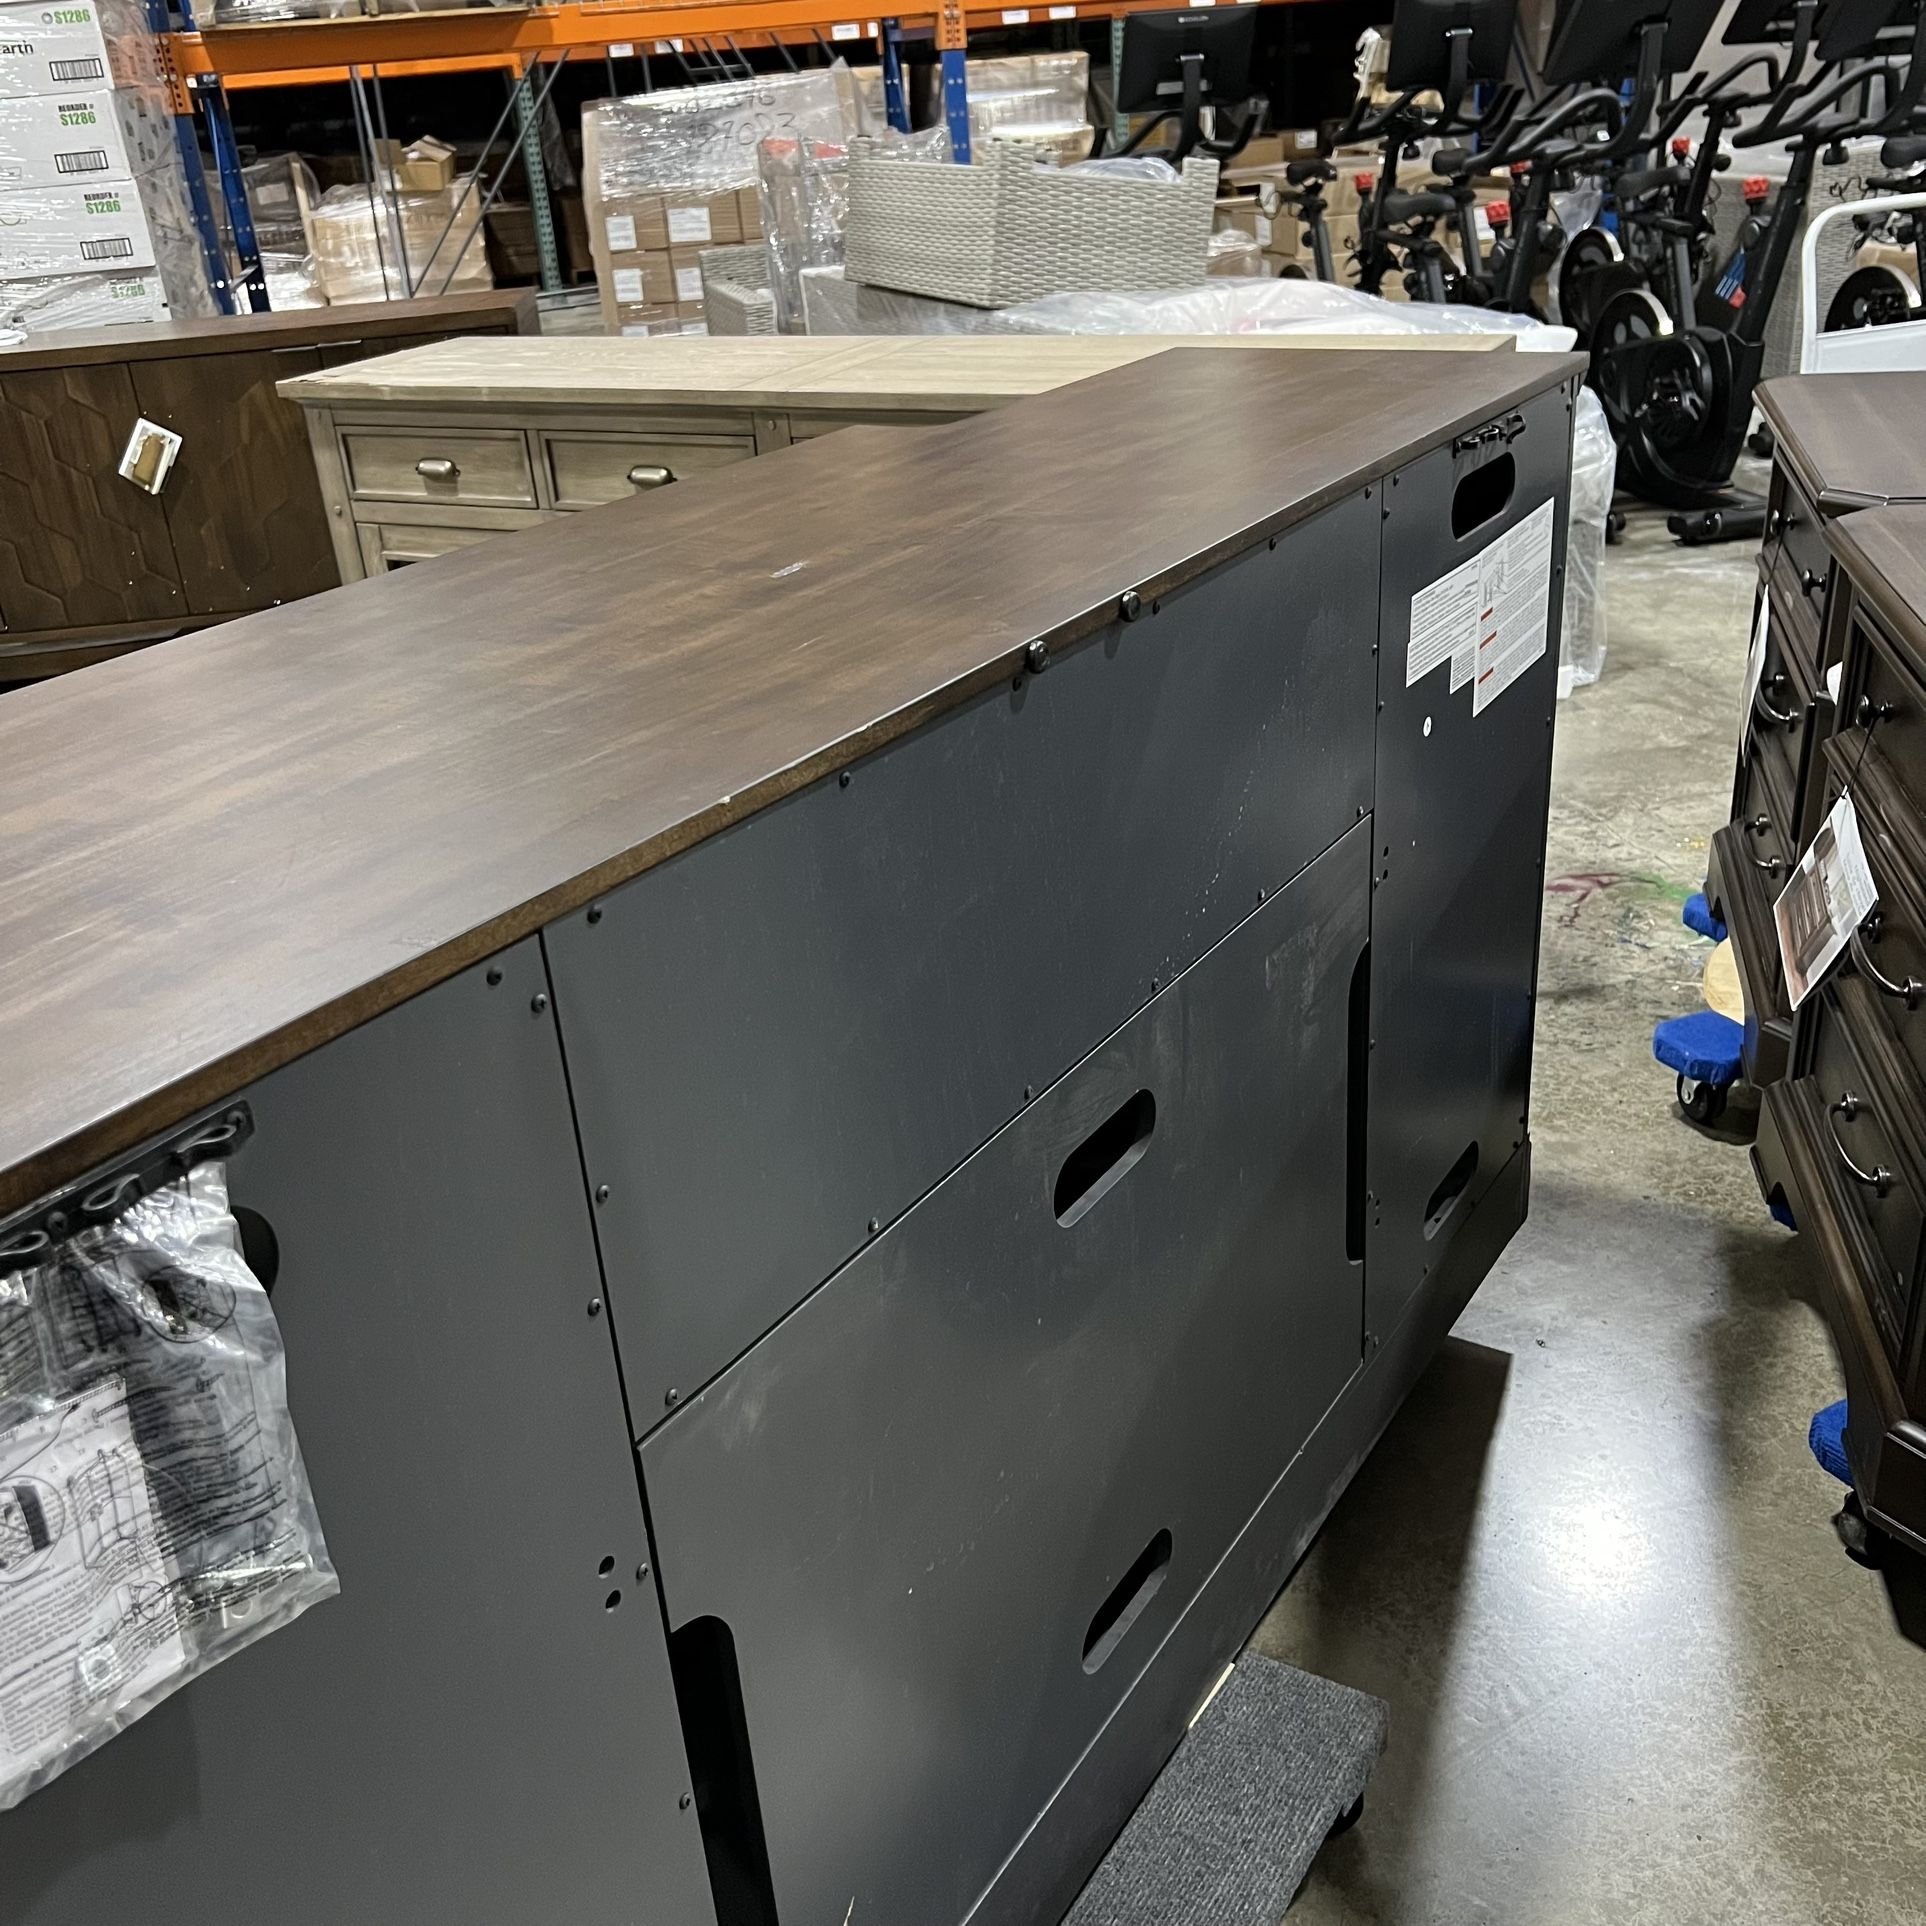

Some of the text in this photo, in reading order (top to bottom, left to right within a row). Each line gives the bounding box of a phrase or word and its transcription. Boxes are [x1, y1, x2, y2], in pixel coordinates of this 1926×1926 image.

[54, 9, 90, 24] S1286
[0, 40, 34, 55] arth
[60, 111, 96, 126] S1286
[86, 200, 121, 214] S1286
